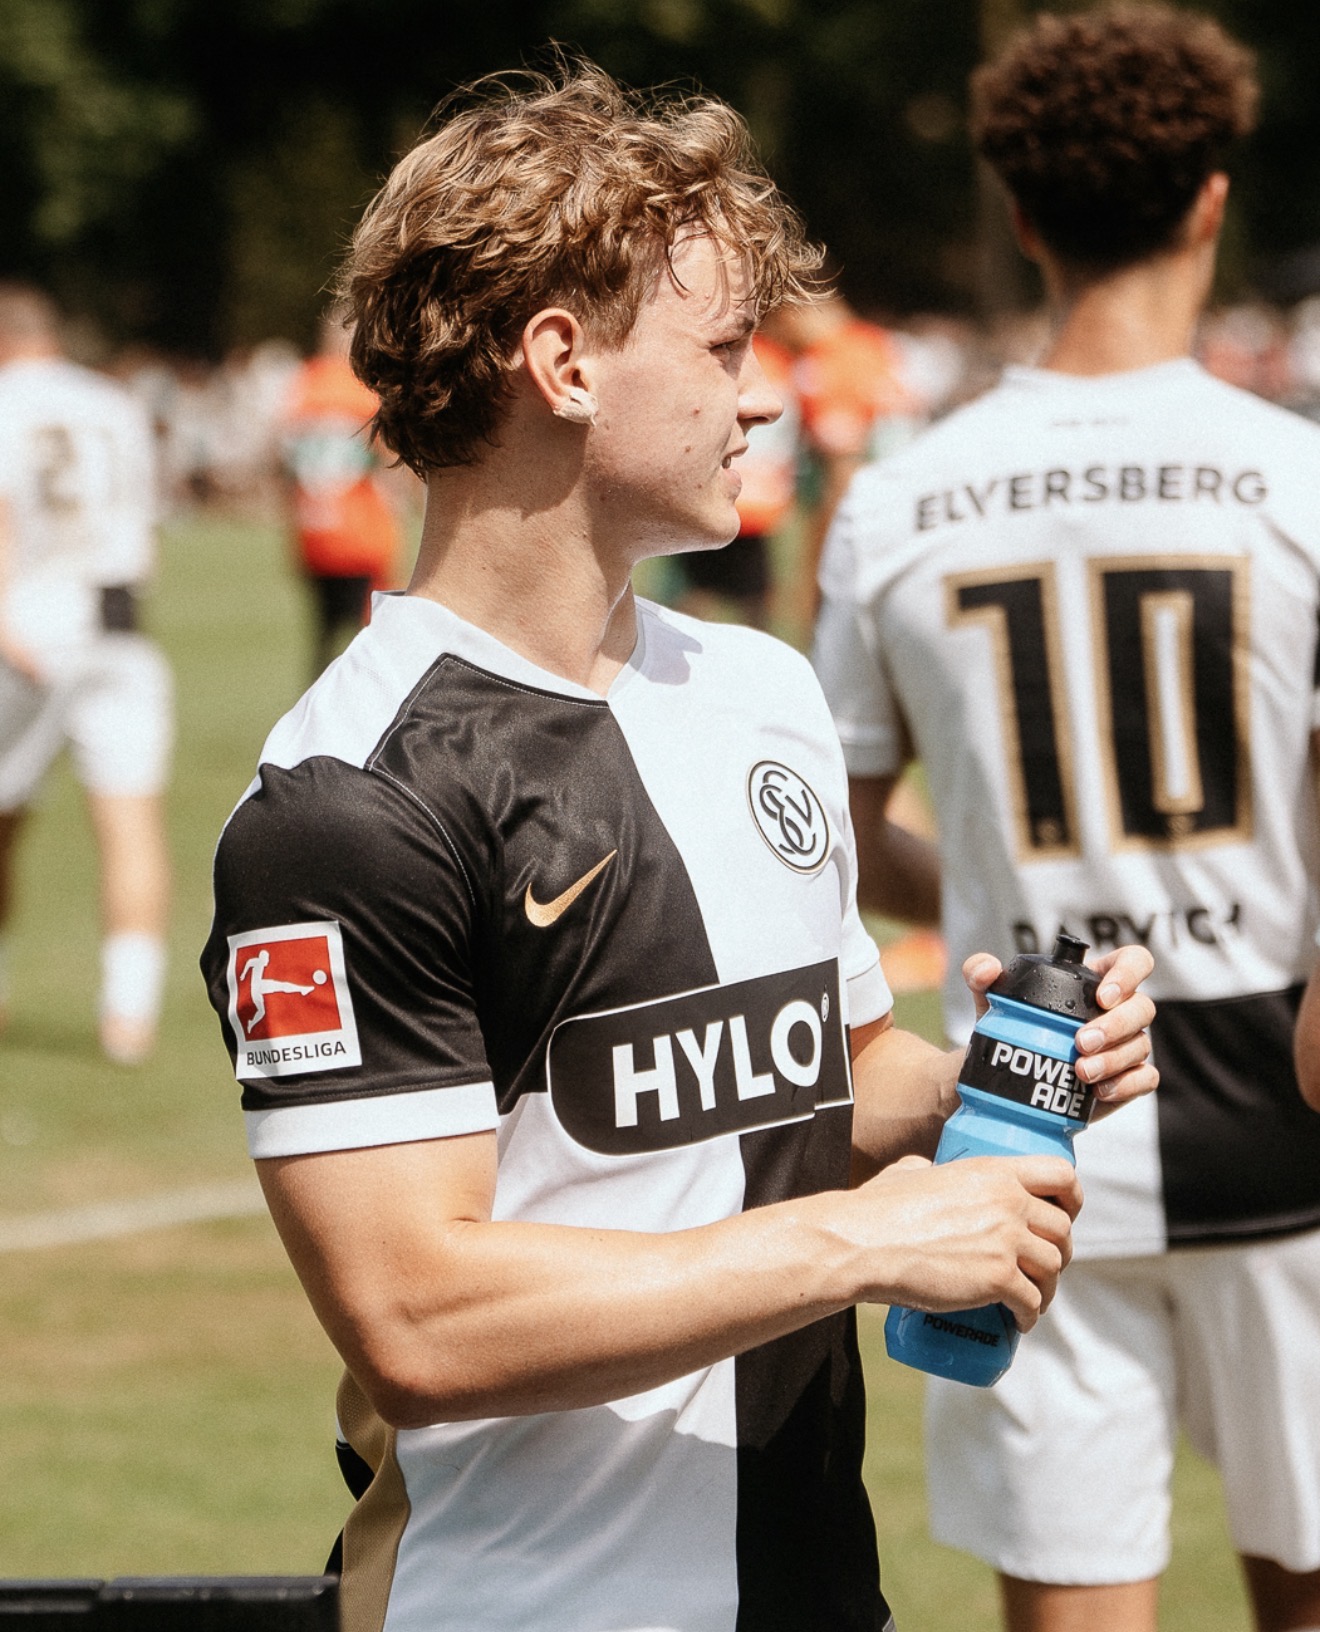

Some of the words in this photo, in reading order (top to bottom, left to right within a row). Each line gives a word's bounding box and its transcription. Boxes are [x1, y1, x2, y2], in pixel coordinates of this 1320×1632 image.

[914, 463, 1268, 533] ELVERSBERG
[943, 553, 1254, 866] 10
[246, 1040, 347, 1066] BUNDESLIGA
[1030, 1081, 1086, 1119] ADE
[923, 1312, 999, 1348] POWERADE
